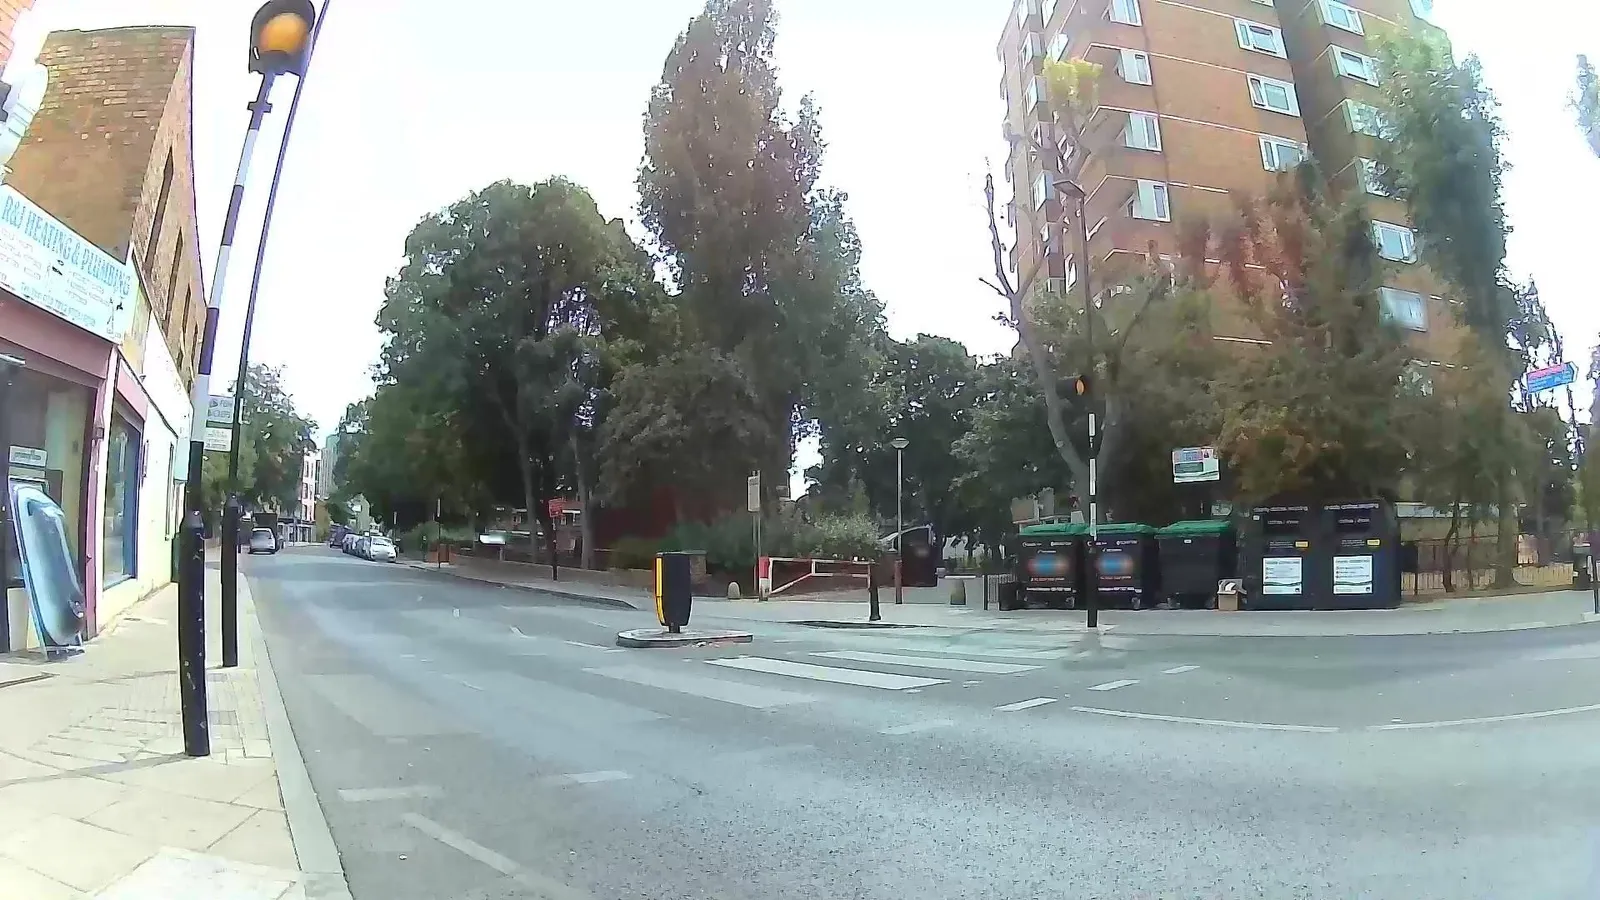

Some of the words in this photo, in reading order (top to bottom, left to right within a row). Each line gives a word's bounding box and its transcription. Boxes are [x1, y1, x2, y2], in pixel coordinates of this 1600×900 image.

[1, 195, 26, 229] R&J
[24, 210, 73, 260] HEATING
[71, 242, 81, 267] &
[80, 248, 131, 297] PLUMBING
